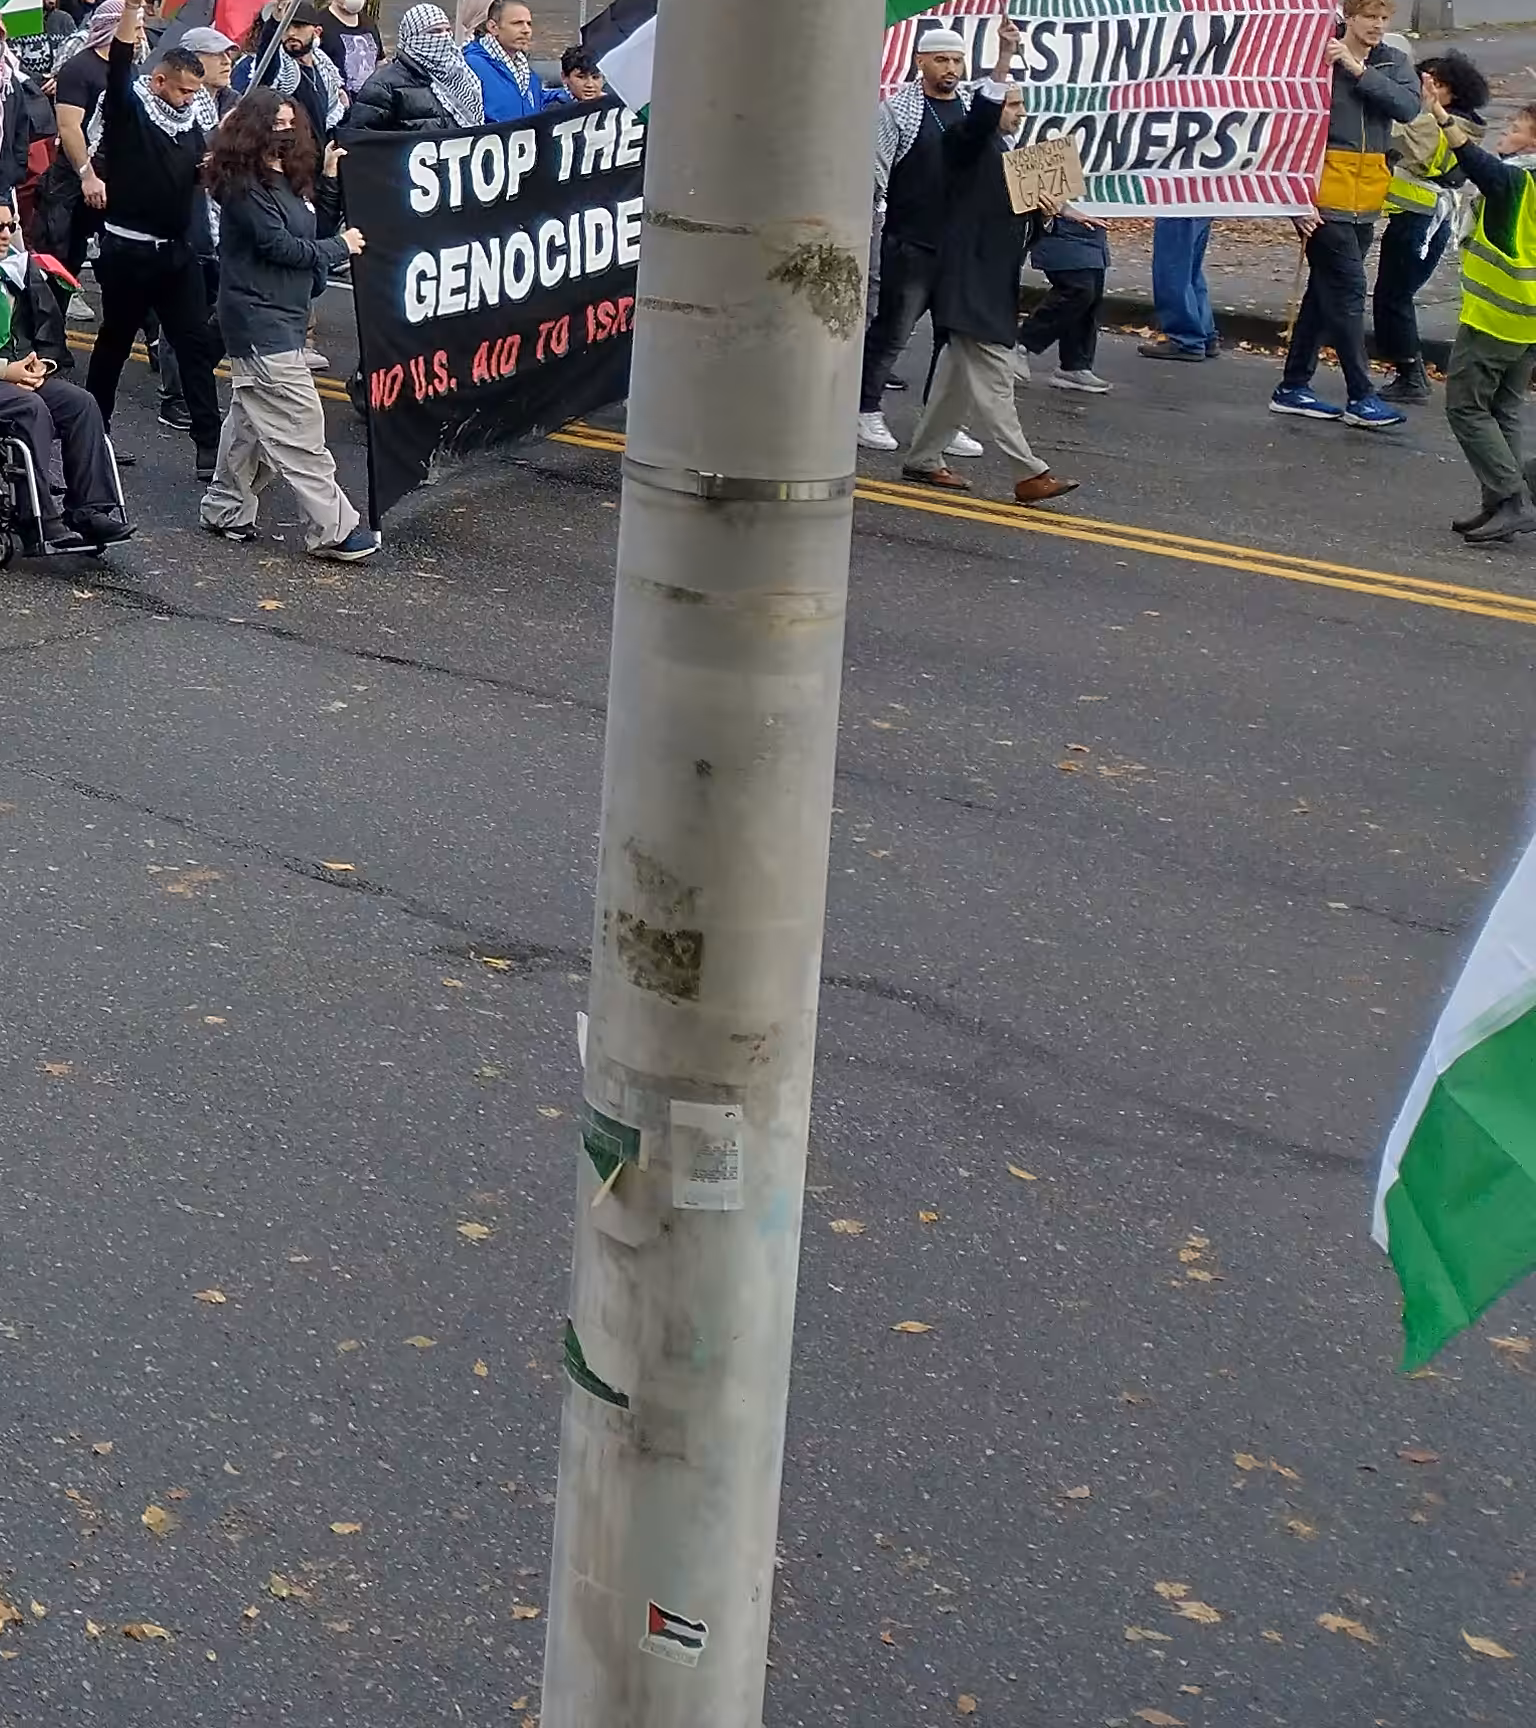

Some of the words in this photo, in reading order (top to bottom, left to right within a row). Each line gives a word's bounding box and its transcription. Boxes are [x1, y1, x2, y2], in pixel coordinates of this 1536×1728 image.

[408, 129, 537, 215] STOP
[552, 106, 645, 183] THE
[1014, 111, 1271, 172] ISONERS!
[1019, 165, 1072, 208] GAZA
[404, 196, 644, 324] GENOCIDE
[370, 363, 404, 410] NO
[409, 349, 458, 402] U.S.
[471, 333, 521, 384] AID
[536, 314, 570, 361] TO
[585, 296, 636, 343] ISR
